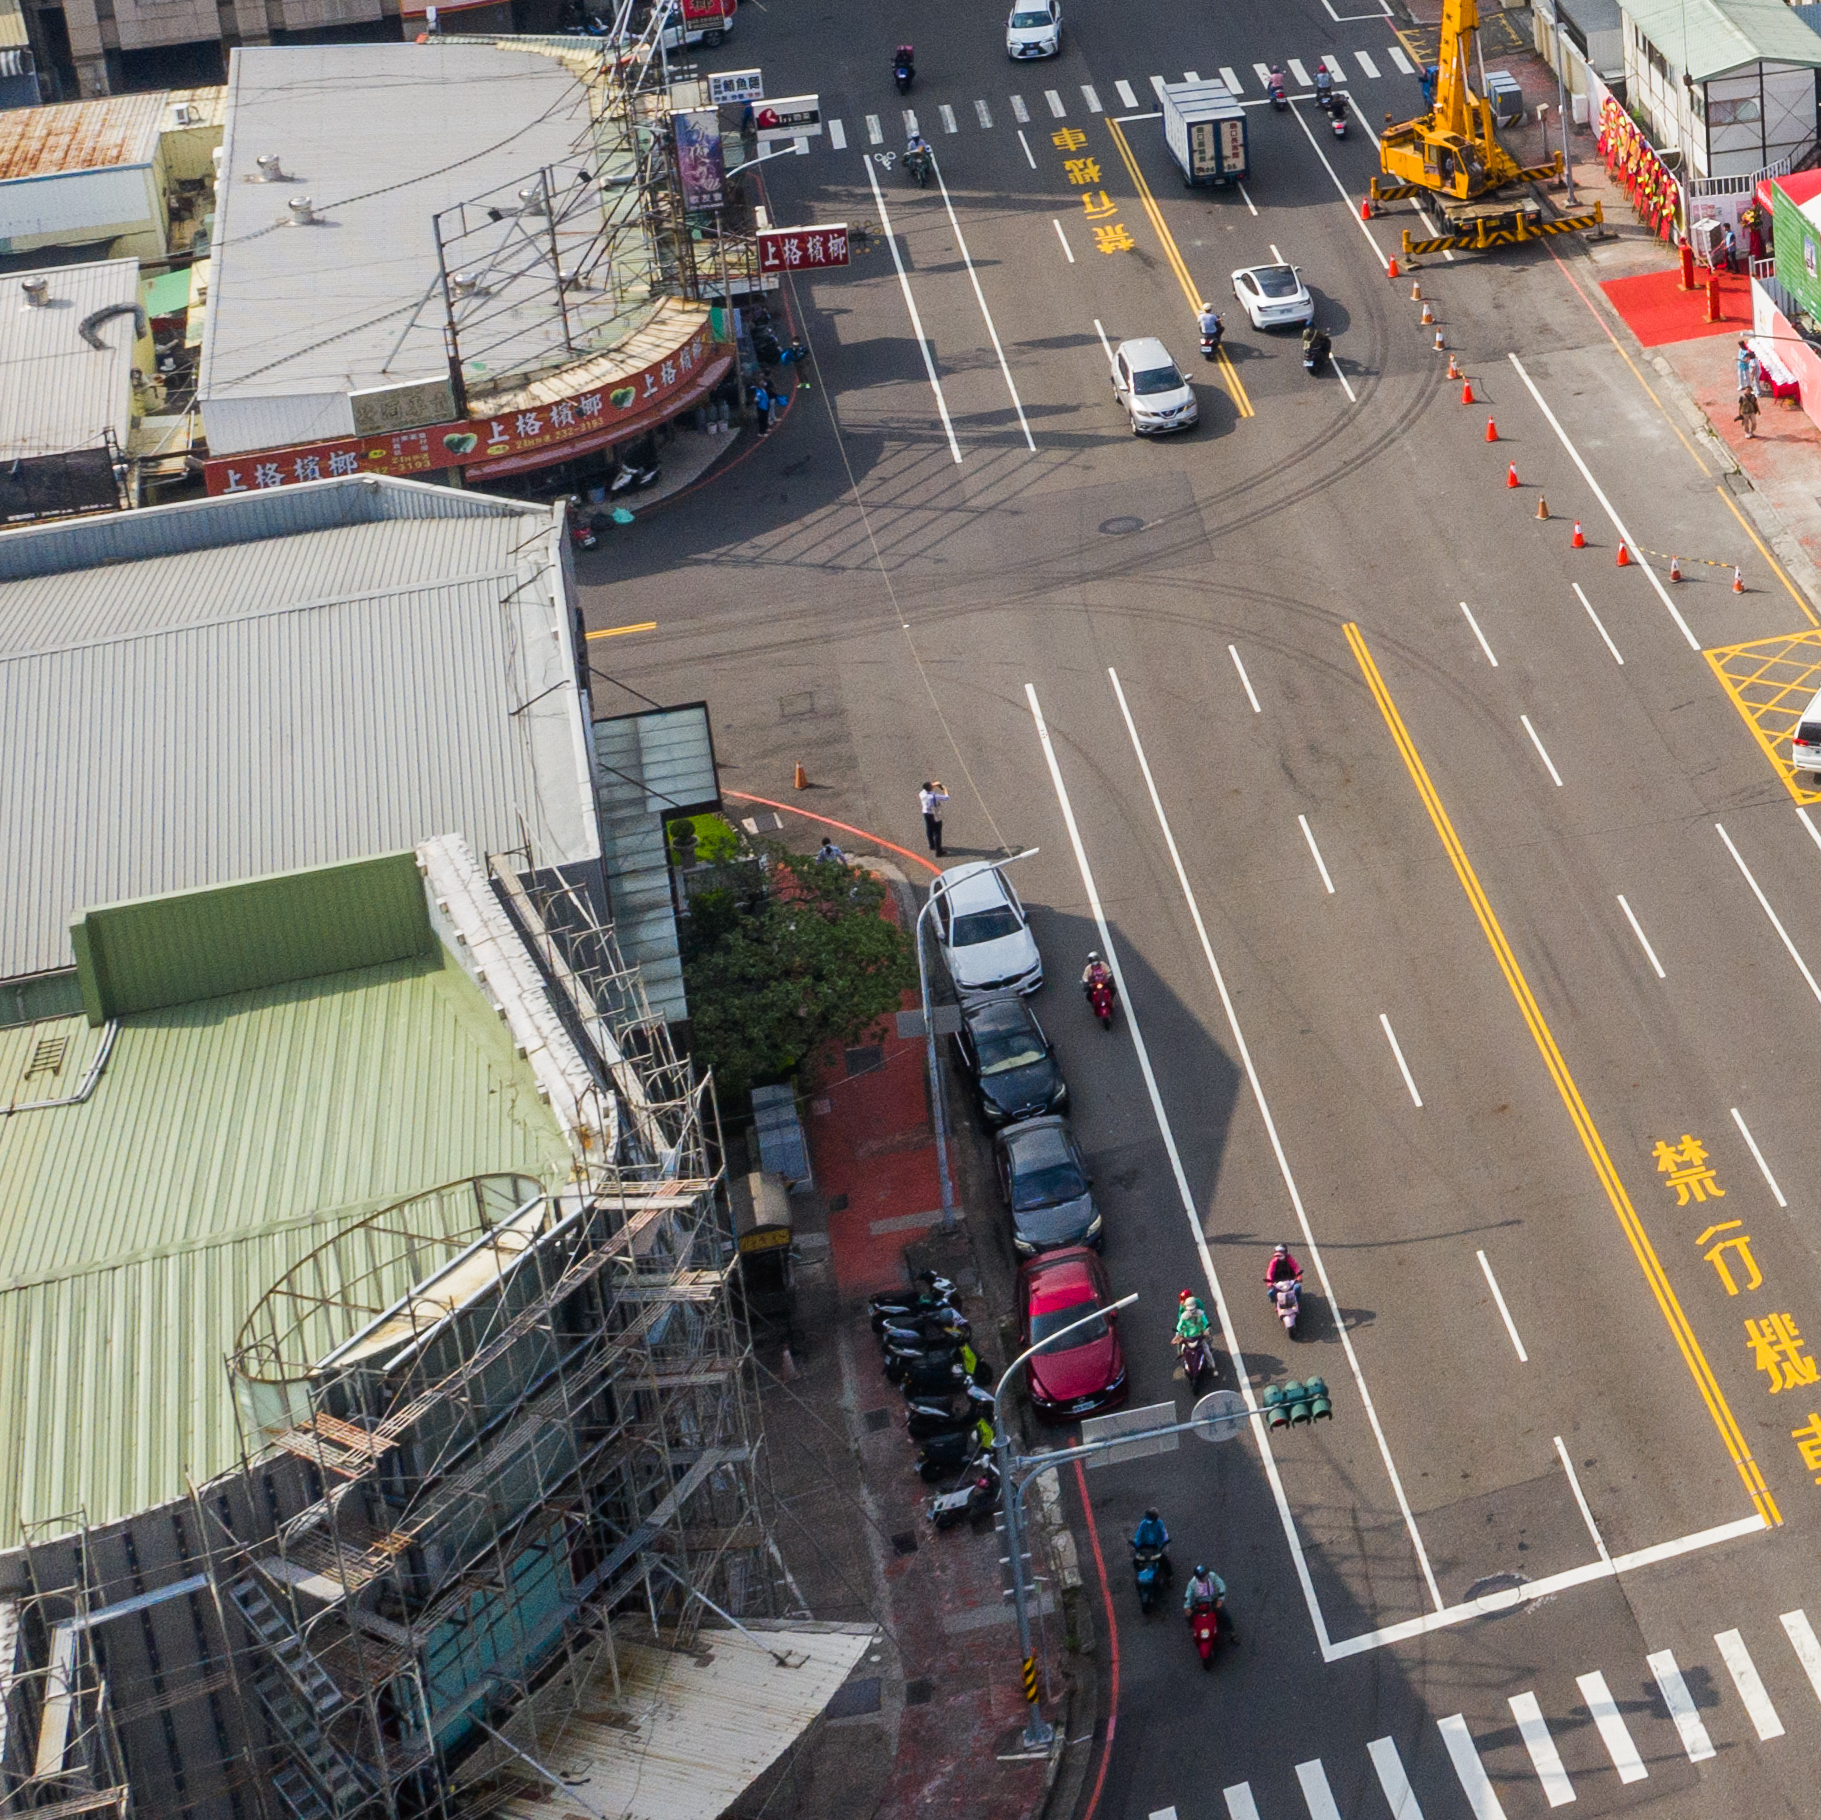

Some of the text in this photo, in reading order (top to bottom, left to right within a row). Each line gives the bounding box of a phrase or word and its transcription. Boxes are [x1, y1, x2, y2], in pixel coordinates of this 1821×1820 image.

[764, 232, 847, 267] 上格檳榔
[487, 392, 604, 444] 上格檳榔
[222, 449, 359, 494] 上格檳榔
